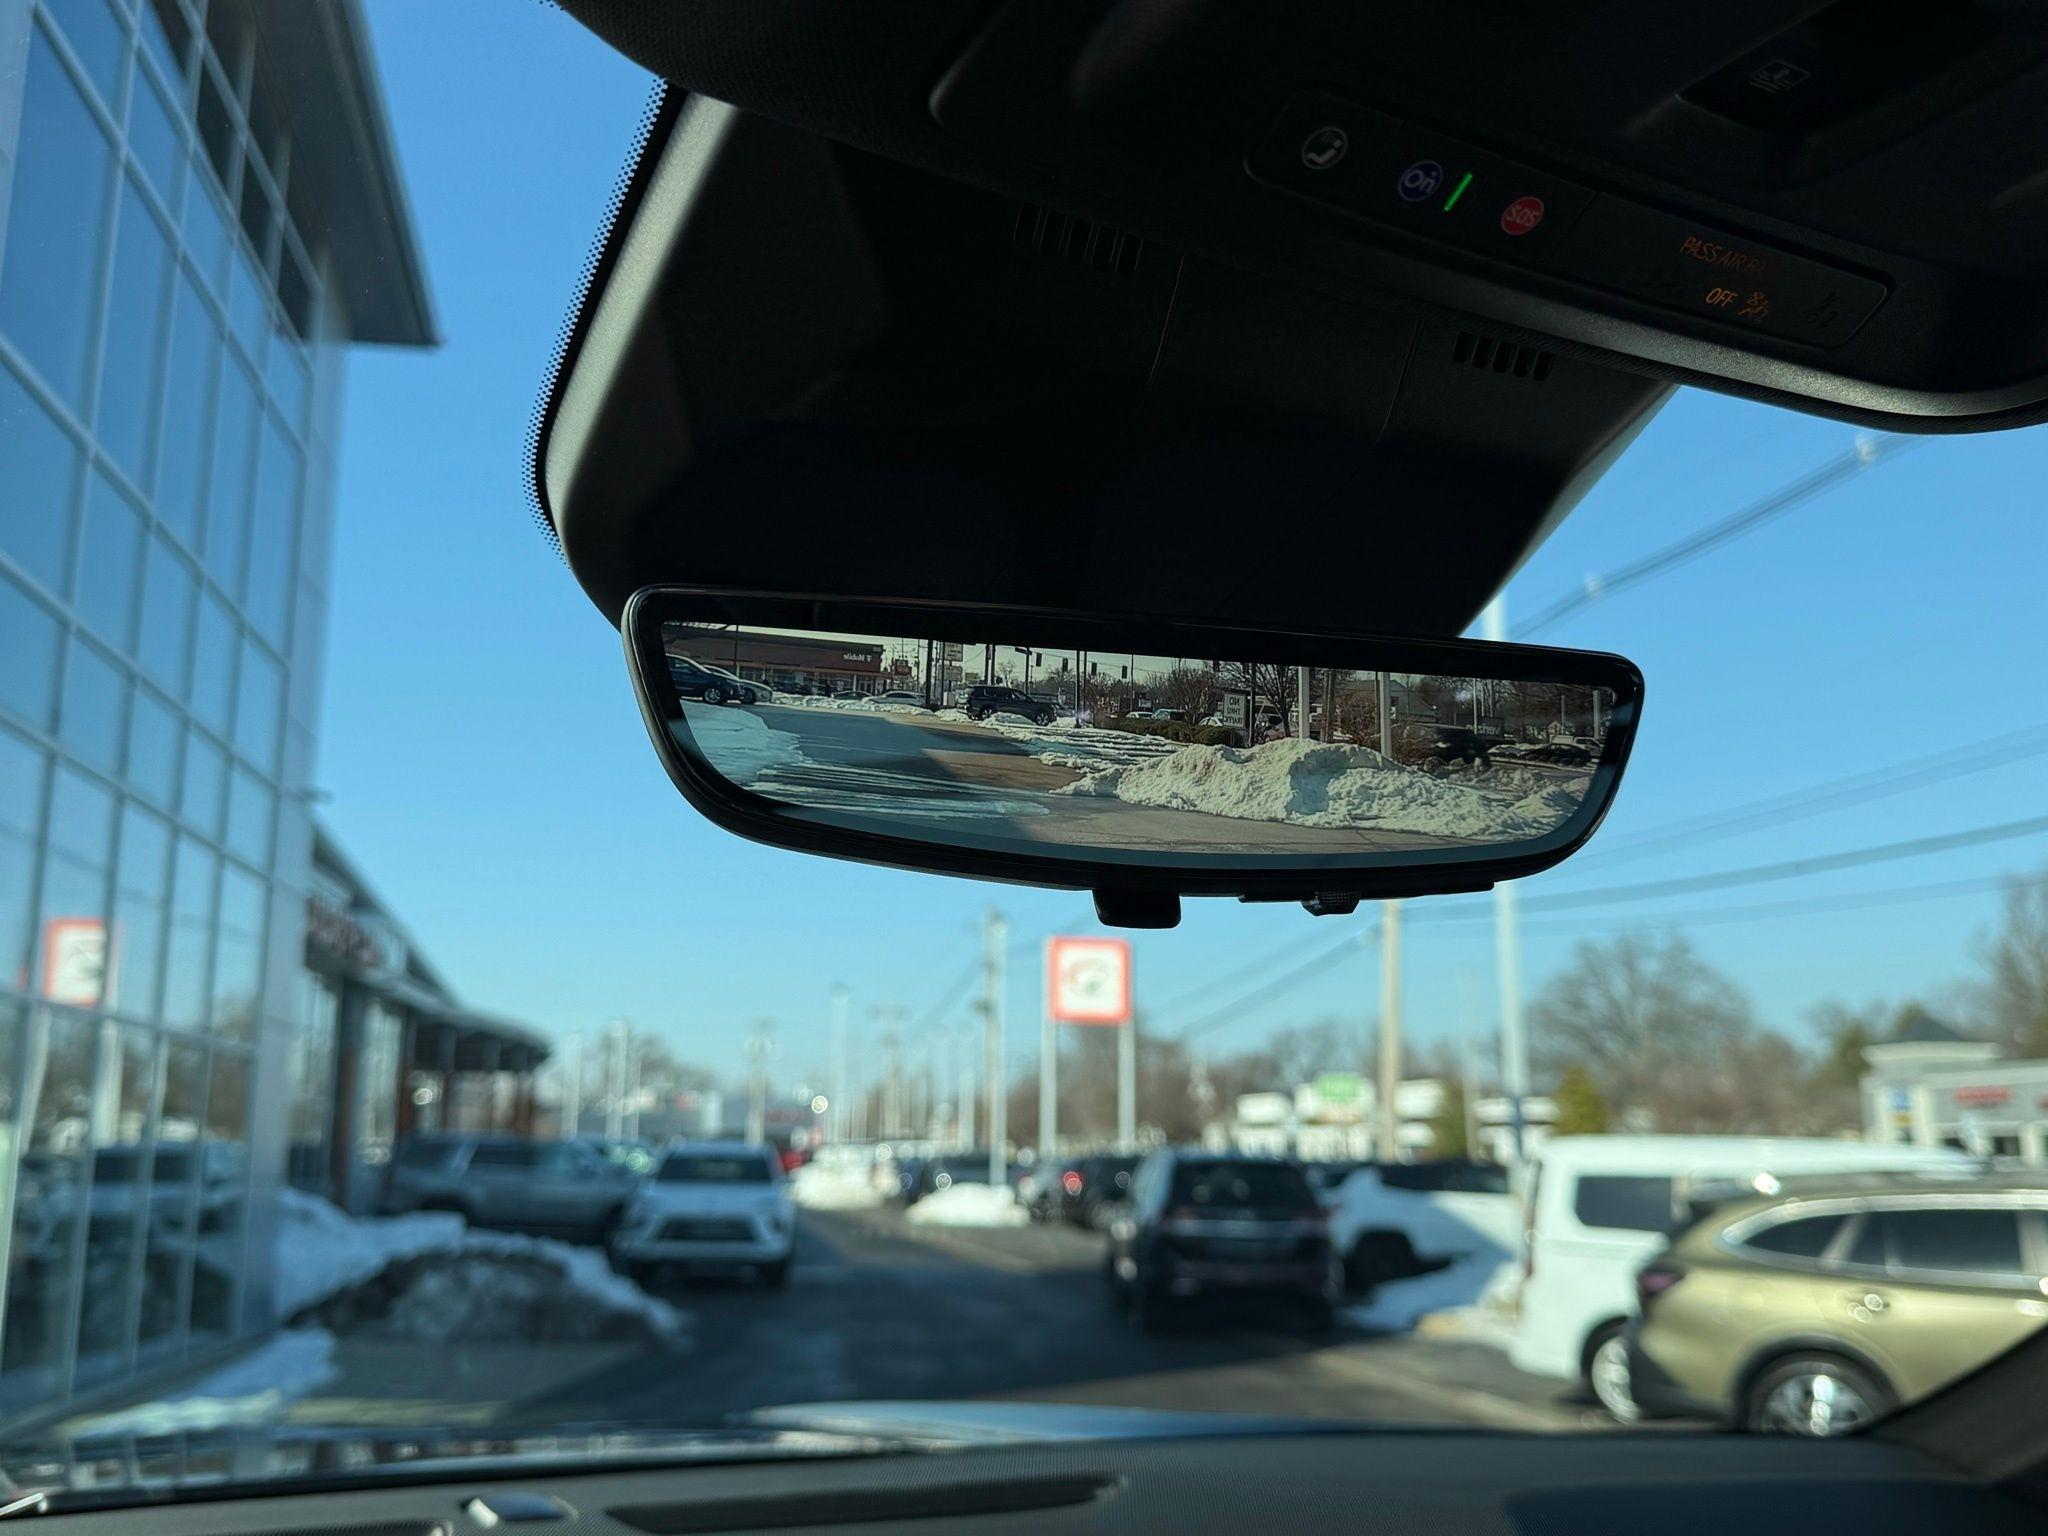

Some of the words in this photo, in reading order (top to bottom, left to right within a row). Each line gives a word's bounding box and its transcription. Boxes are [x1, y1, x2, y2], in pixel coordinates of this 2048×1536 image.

[1507, 204, 1537, 227] SOS
[1681, 236, 1722, 263] PASS
[1706, 288, 1738, 308] OFF
